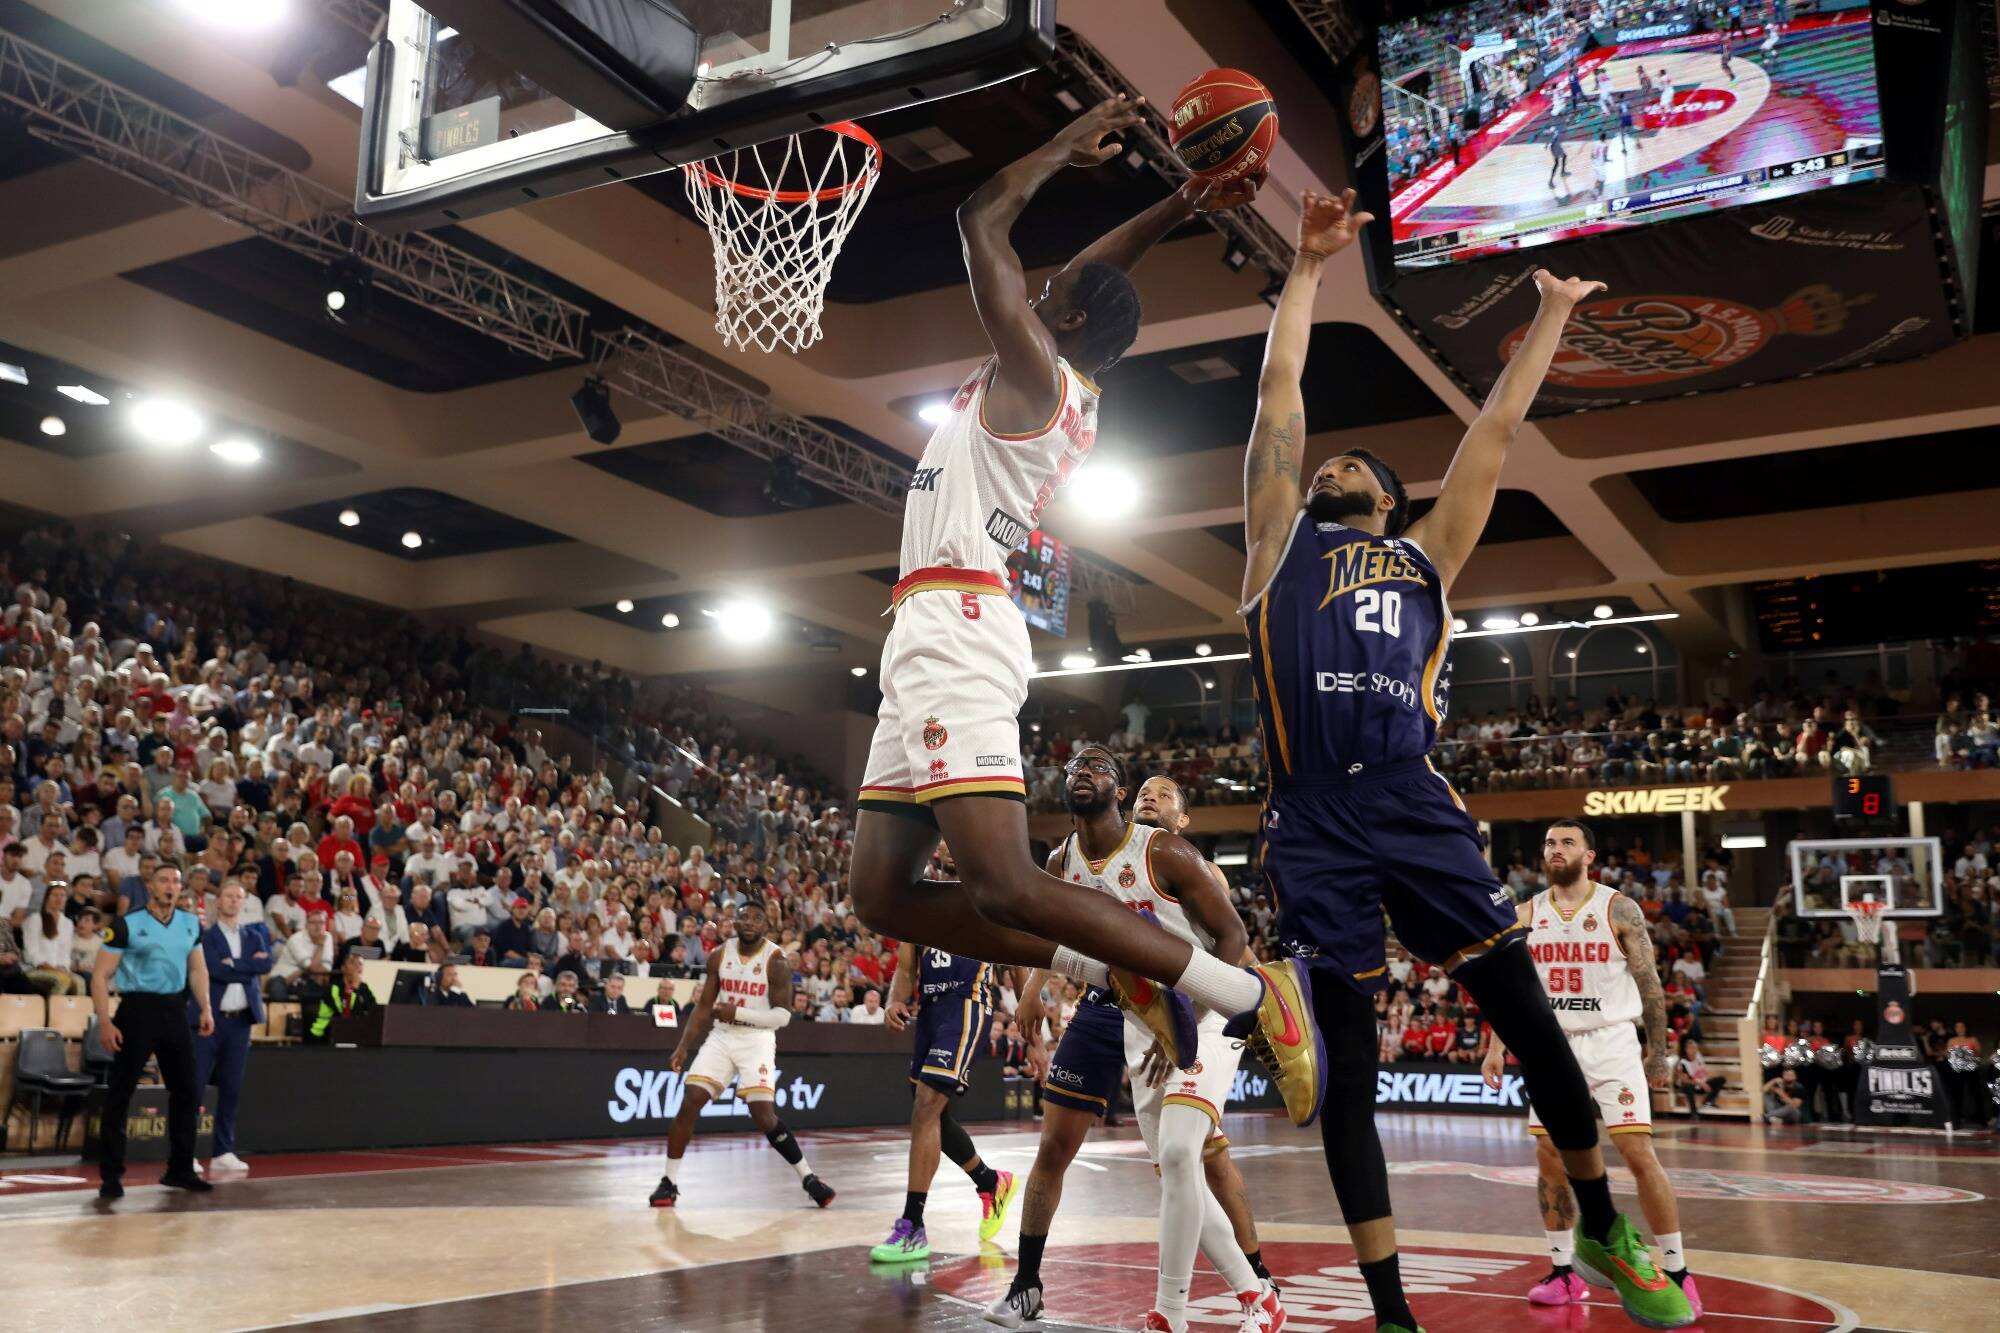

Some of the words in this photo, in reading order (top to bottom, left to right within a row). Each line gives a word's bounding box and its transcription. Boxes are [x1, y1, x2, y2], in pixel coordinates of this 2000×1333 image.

[1791, 157, 1825, 175] 3:43
[1612, 197, 1630, 211] 57
[960, 593, 982, 621] 5
[1355, 589, 1401, 638] 20
[1316, 671, 1366, 692] IDEC
[1371, 673, 1415, 707] SPORT
[977, 756, 1006, 766] MONACO
[1848, 779, 1860, 794] 3
[1583, 785, 1730, 816] SKWEEK
[1863, 793, 1879, 815] 8
[1528, 943, 1610, 964] MONACO
[719, 977, 767, 998] MONACO
[1548, 967, 1584, 993] 55
[1547, 998, 1601, 1011] WEEK
[1056, 1066, 1084, 1086] idex
[1868, 1068, 1933, 1095] FINALES
